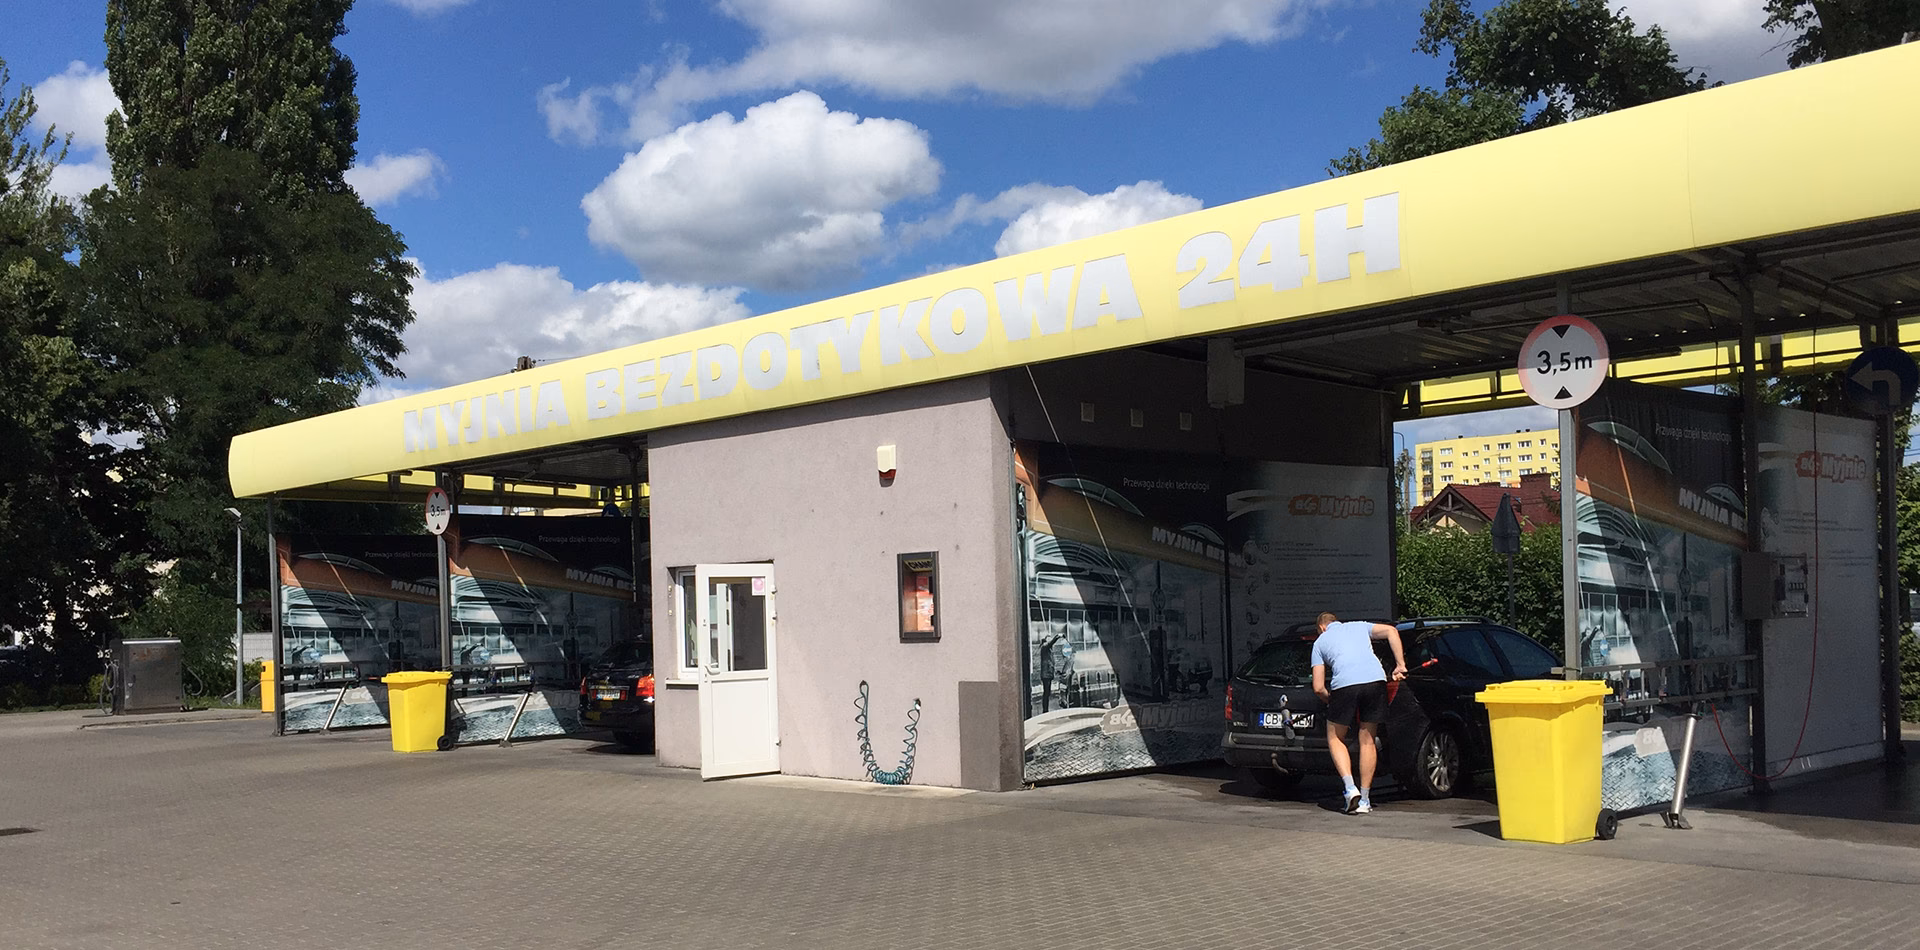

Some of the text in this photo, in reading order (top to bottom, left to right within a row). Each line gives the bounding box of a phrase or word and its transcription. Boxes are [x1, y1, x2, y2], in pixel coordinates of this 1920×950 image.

[404, 191, 1401, 453] MYJNIA BEZDOTYKOWA 24H
[1822, 455, 1866, 481] Myjnie
[1122, 477, 1155, 490] Przewaga
[1320, 496, 1374, 518] Myjnie
[1679, 487, 1729, 525] MYJNIA
[538, 535, 568, 544] Przewaga
[1152, 526, 1203, 555] MYJNIA
[391, 579, 437, 597] MYJNIA
[566, 568, 614, 587] MYJNIA
[1140, 702, 1208, 729] Myjnie
